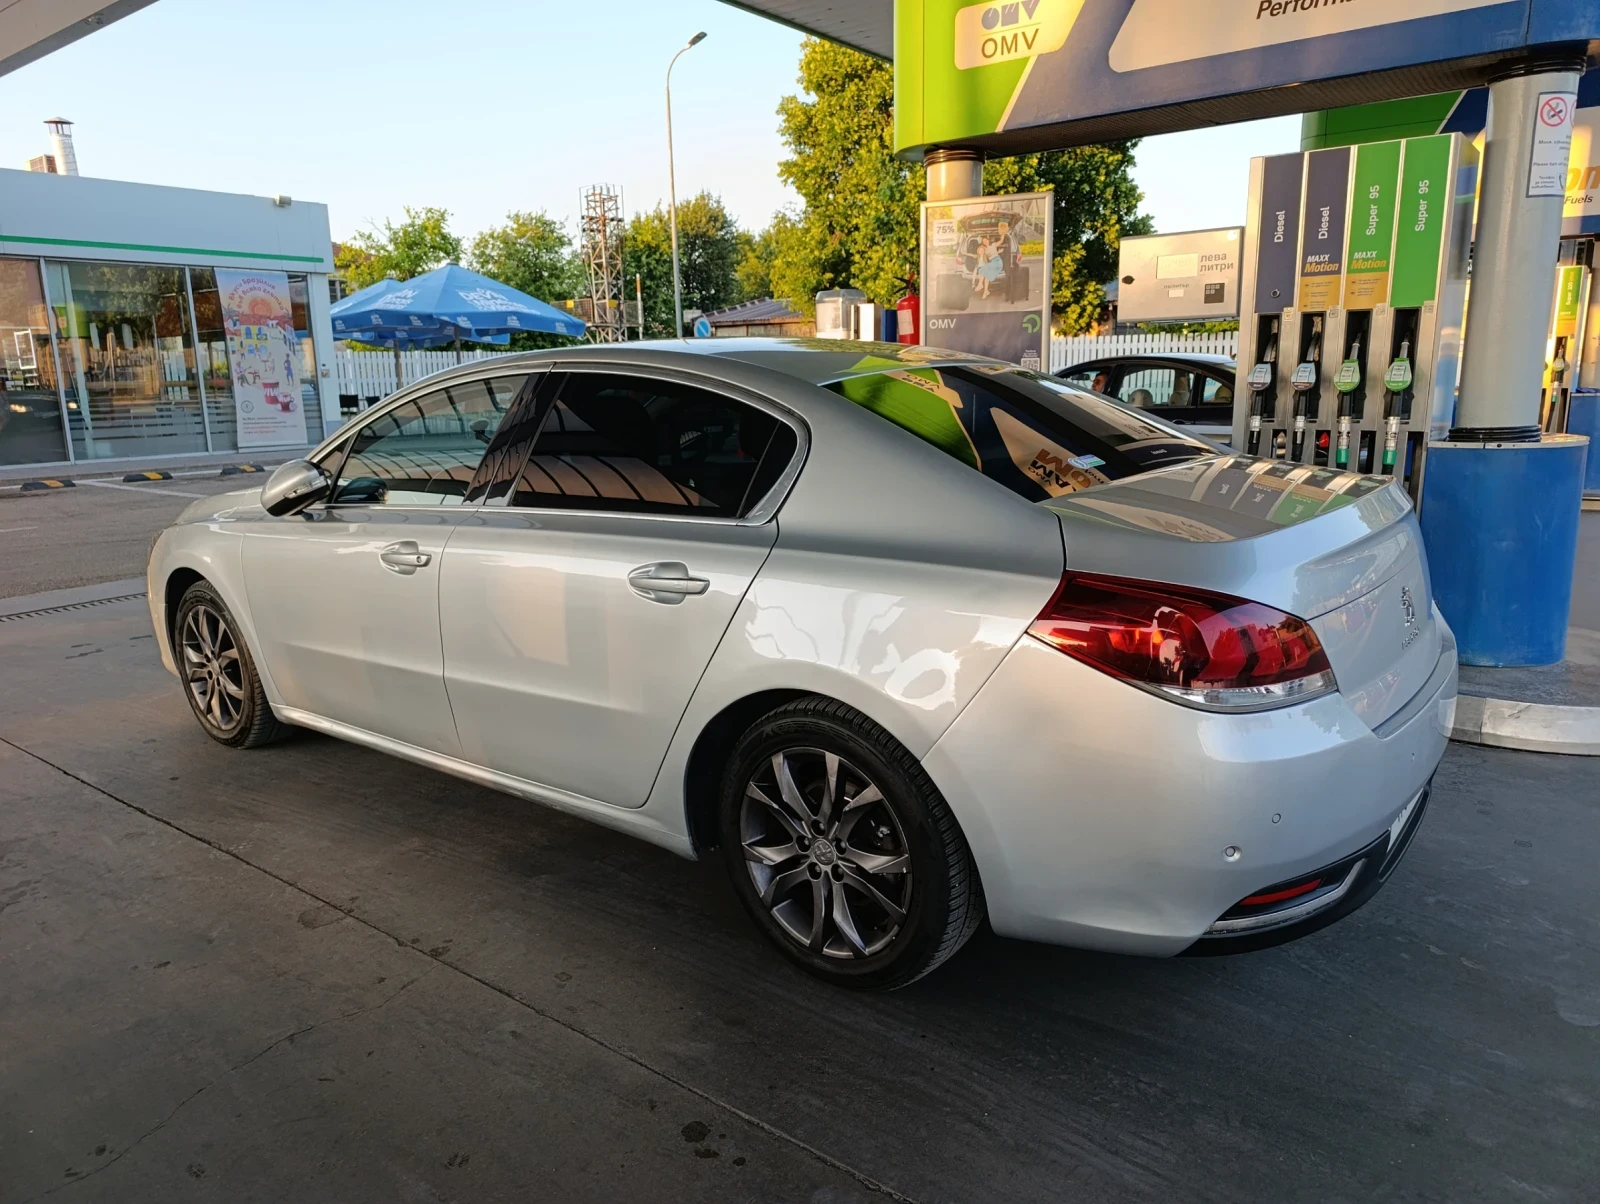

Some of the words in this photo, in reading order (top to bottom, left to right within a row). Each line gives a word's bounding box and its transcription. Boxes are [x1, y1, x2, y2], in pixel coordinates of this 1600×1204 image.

[981, 28, 1039, 58] OMV
[1369, 184, 1380, 199] 95
[1419, 179, 1429, 195] 95
[1564, 195, 1593, 204] Fuels
[1366, 204, 1379, 236] Super
[1415, 199, 1428, 232] Super
[1274, 210, 1286, 243] Diesel
[1318, 206, 1330, 239] Diesel
[936, 225, 955, 234] 75%
[1200, 253, 1227, 262] лева
[1307, 254, 1330, 263] MAXX
[1353, 251, 1377, 260] MAXX
[1200, 262, 1234, 272] литри
[1304, 262, 1339, 273] Motion
[1351, 259, 1387, 270] Motion
[242, 277, 276, 290] Бразилия
[929, 318, 957, 330] OMV
